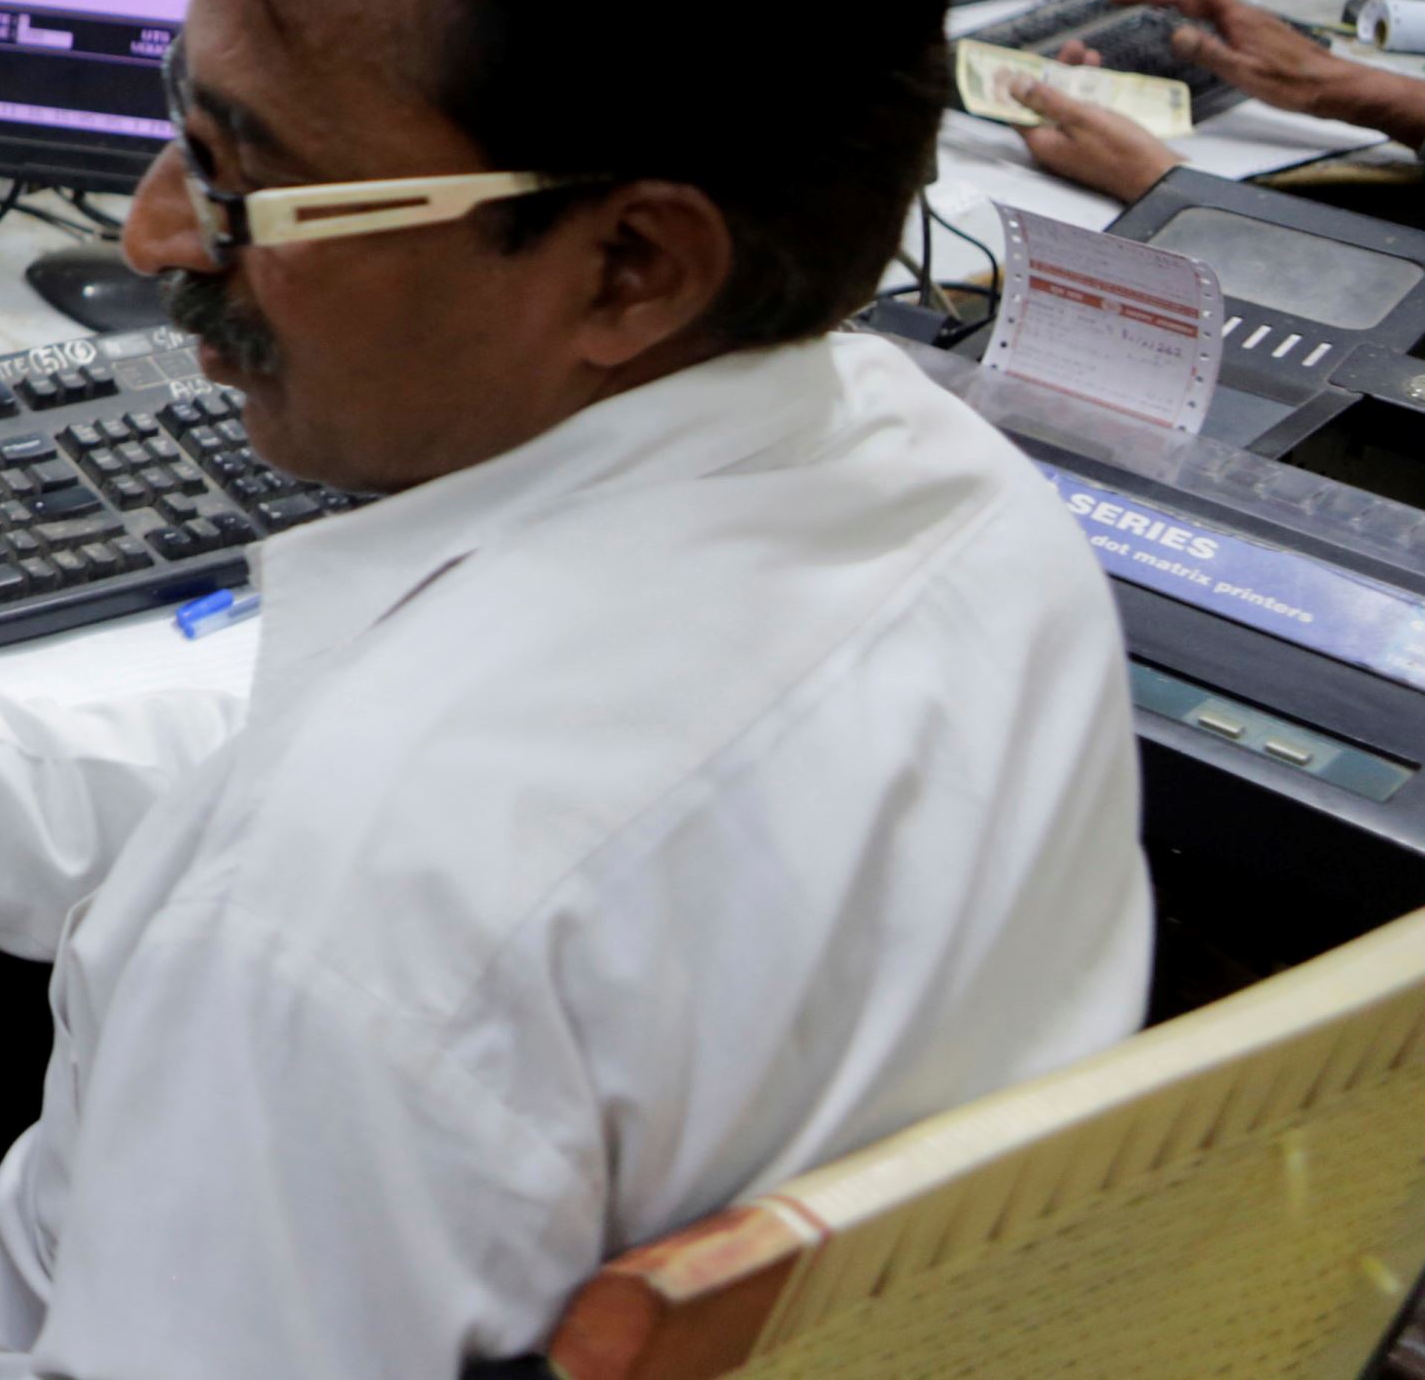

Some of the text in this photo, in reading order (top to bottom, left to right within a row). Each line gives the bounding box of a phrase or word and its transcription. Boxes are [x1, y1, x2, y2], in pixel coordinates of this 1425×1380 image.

[1066, 493, 1220, 560] SERIES
[1090, 534, 1315, 624] dot matrix printers
